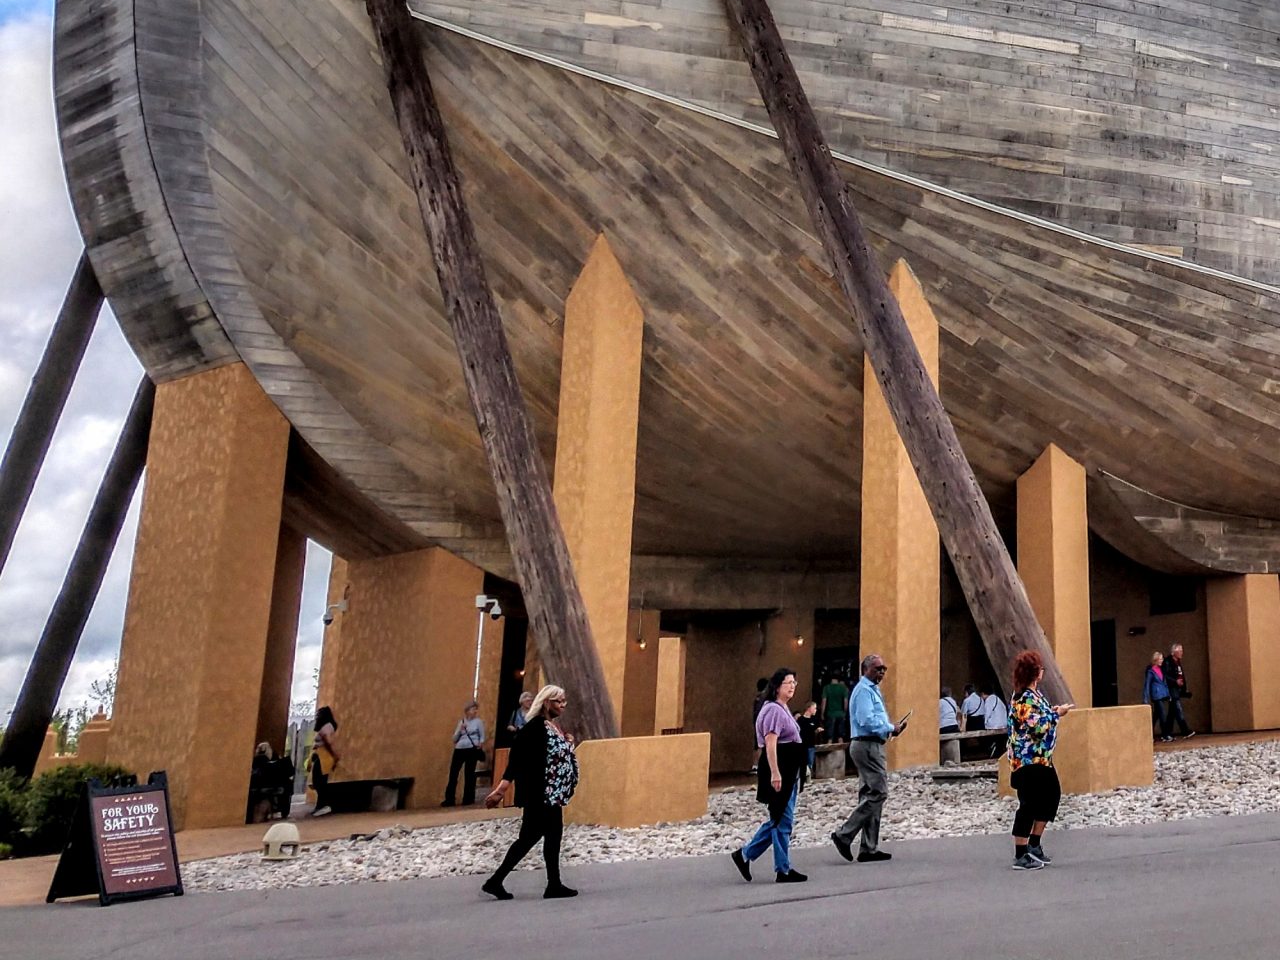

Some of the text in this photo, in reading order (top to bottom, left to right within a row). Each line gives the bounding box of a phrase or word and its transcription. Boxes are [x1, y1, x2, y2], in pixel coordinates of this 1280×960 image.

[101, 803, 159, 818] FOR YOUR
[103, 814, 155, 832] SAFETY
